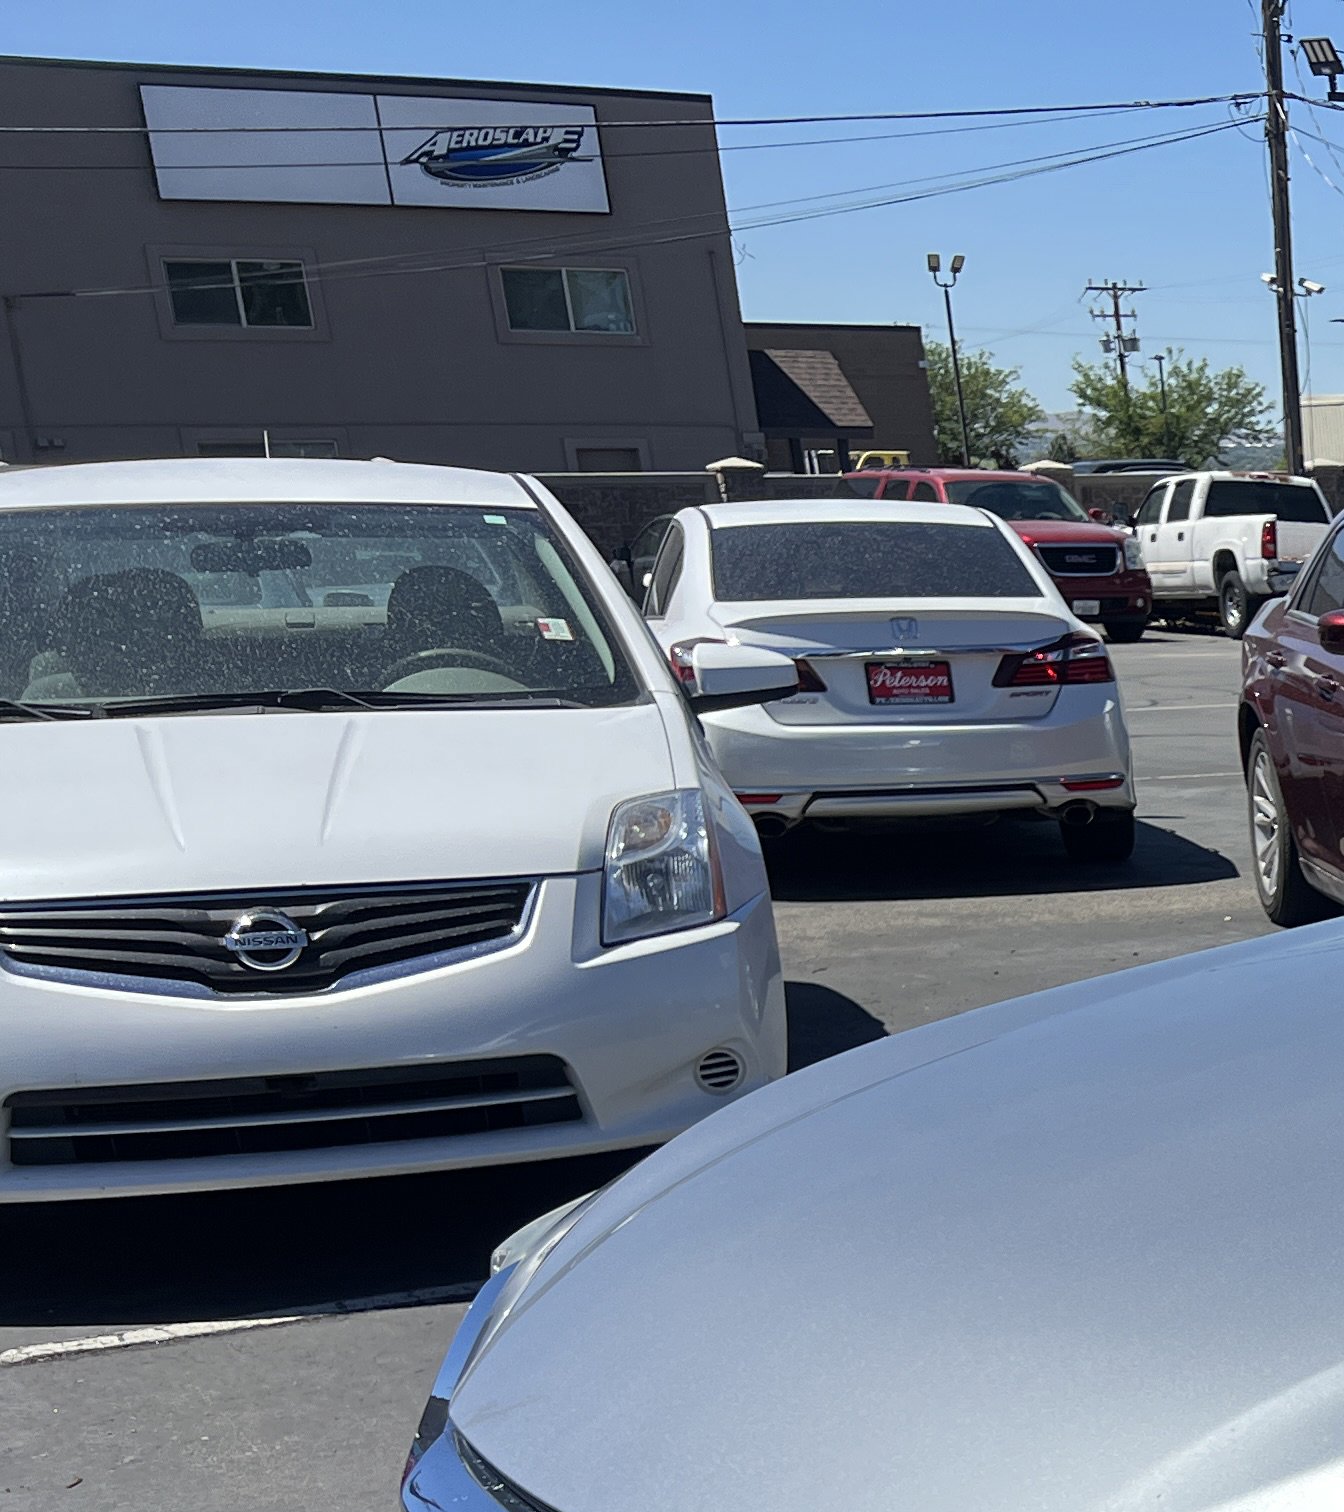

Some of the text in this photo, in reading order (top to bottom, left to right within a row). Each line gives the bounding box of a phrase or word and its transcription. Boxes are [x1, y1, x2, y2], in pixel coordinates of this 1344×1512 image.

[402, 126, 583, 162] AEROSCAPE
[870, 666, 949, 688] Peterson
[234, 935, 298, 946] NISSAN
